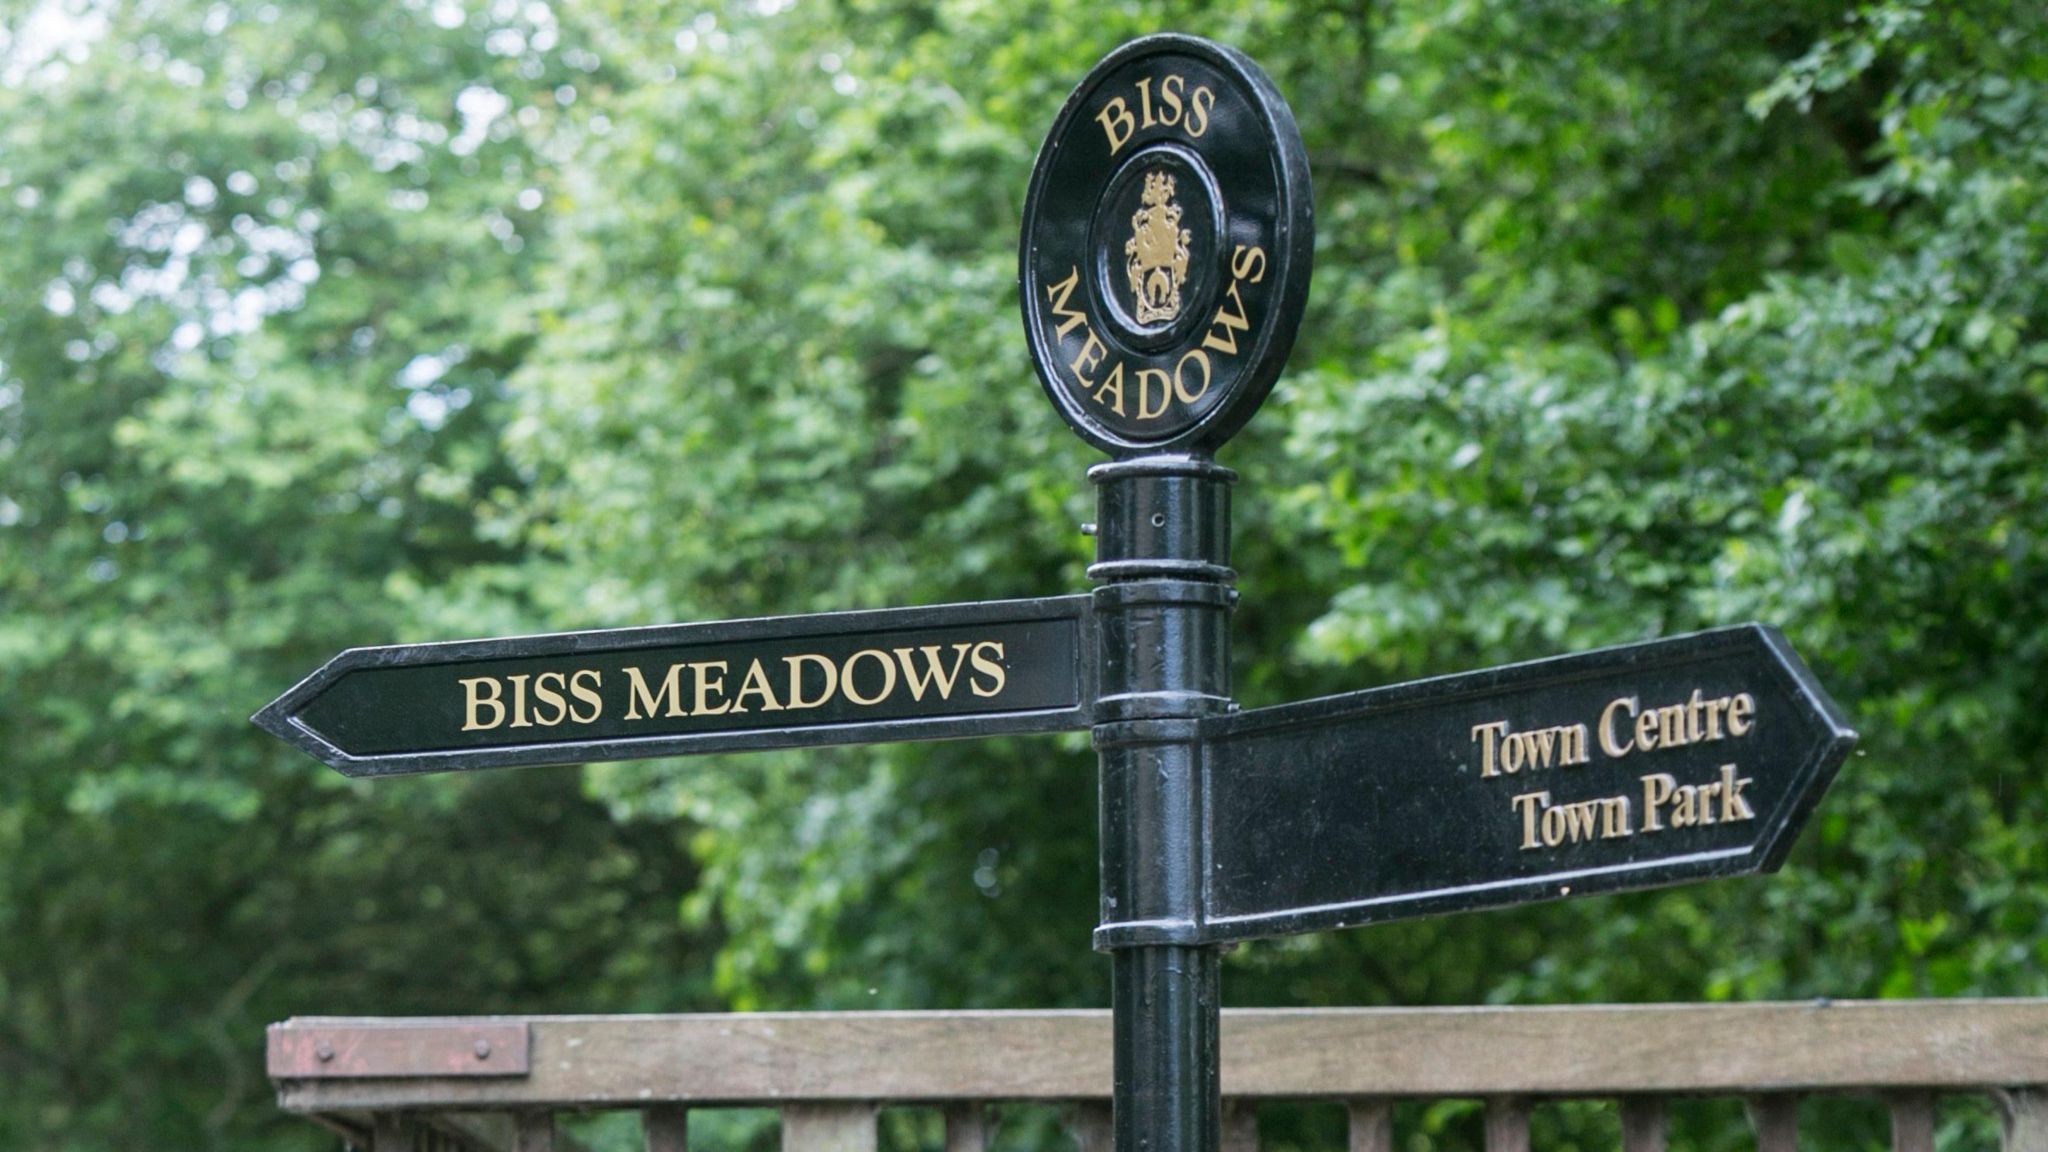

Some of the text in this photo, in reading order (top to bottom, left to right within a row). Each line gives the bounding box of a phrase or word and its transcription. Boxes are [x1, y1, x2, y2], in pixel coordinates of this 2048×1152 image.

[1095, 74, 1215, 156] BISS
[1047, 245, 1266, 421] MEADOWS
[459, 641, 1006, 732] BISS MEADOWS
[1471, 688, 1756, 778] Town Centre
[1511, 763, 1755, 850] Town Park
